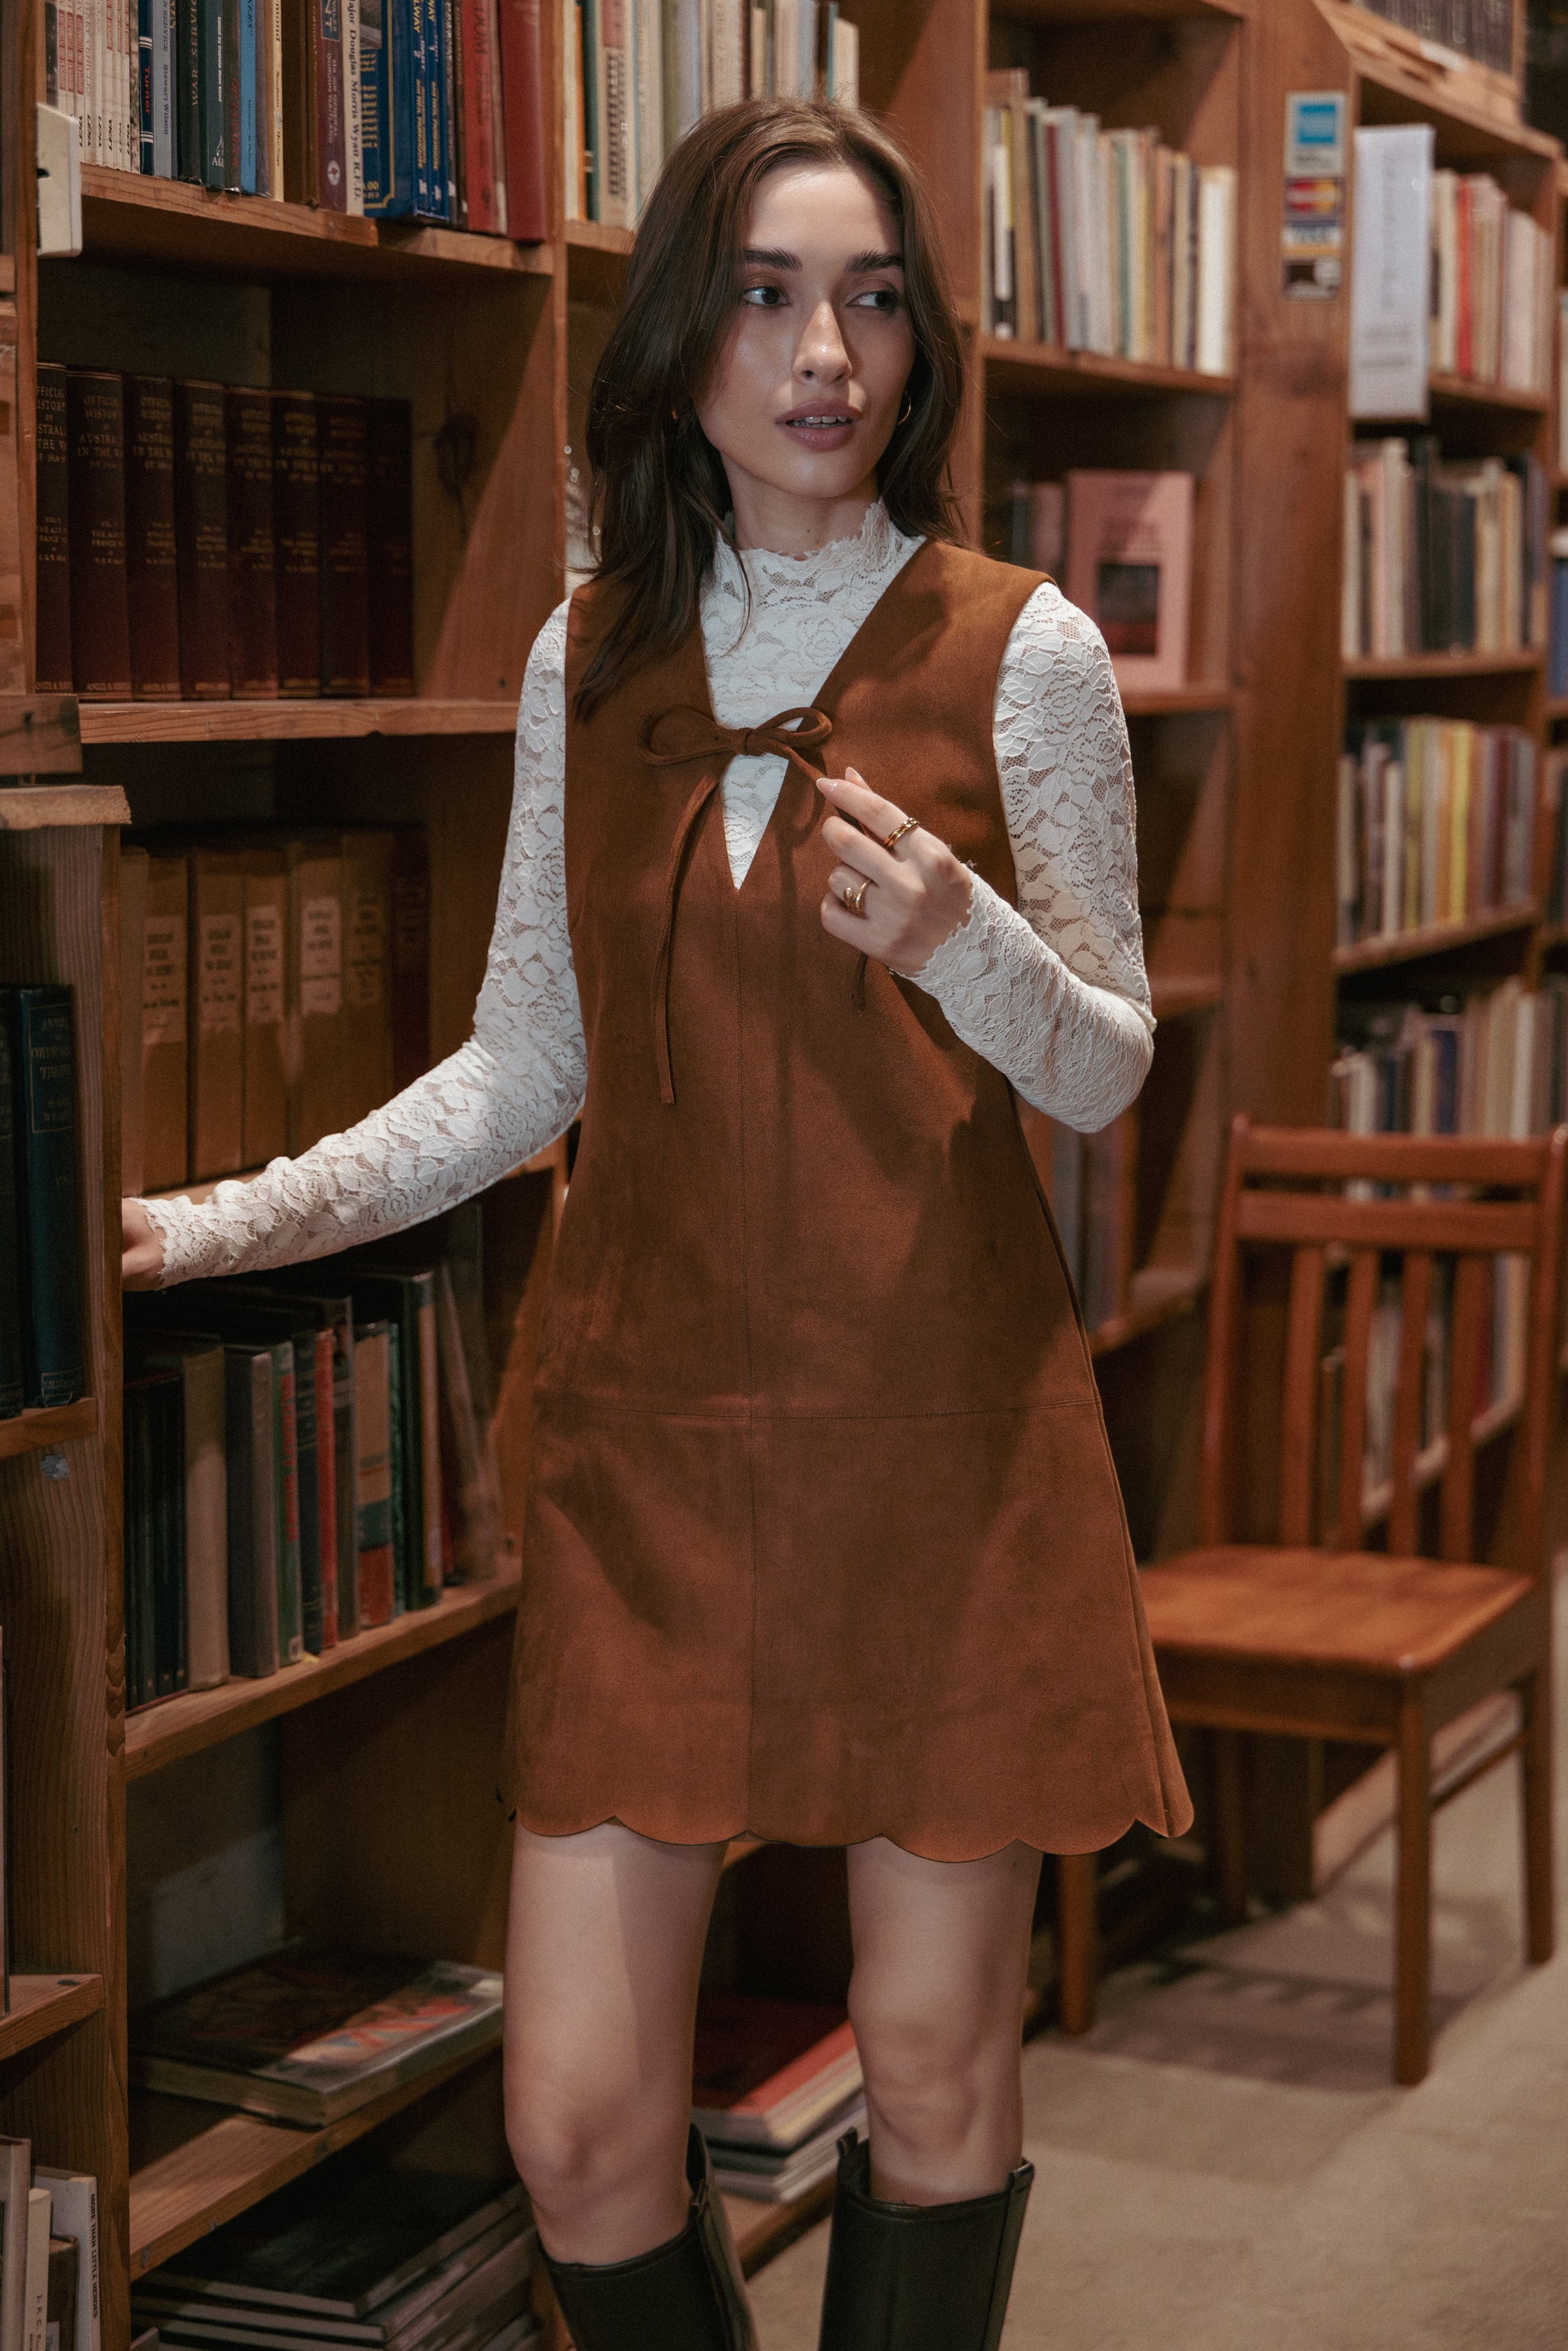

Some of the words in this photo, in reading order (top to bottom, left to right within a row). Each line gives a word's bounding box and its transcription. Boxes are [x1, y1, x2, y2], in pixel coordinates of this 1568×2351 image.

[349, 29, 358, 76] Douglas
[351, 81, 359, 120] Morris
[350, 123, 360, 157] Wyatt
[37, 438, 56, 450] THE
[38, 423, 67, 436] STRAL
